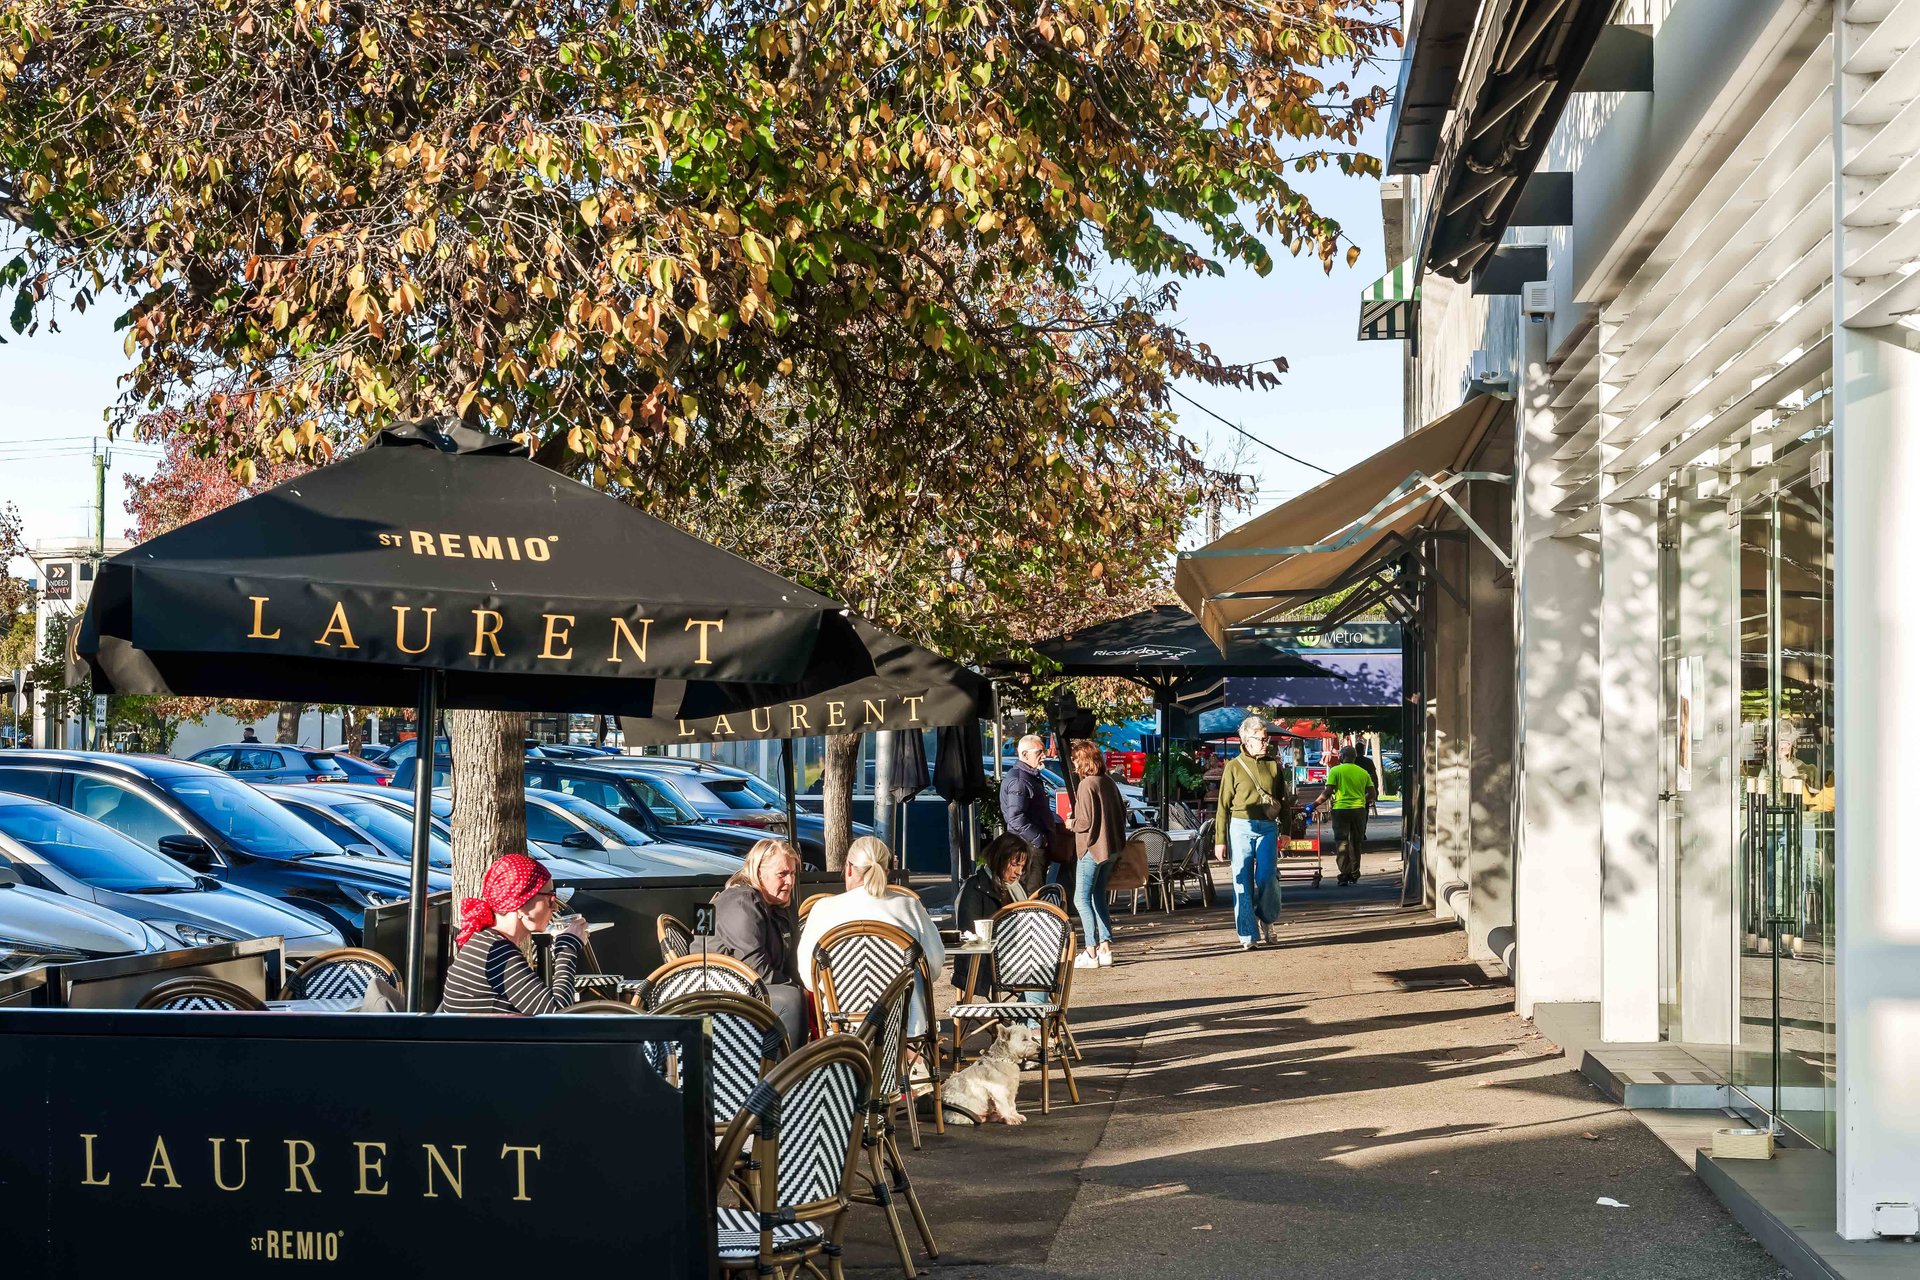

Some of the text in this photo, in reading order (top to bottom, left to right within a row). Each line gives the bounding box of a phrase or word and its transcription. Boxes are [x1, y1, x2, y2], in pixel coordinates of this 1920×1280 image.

[378, 533, 402, 547] ST
[247, 596, 724, 665] LAURENT
[1324, 630, 1363, 644] Metro
[678, 695, 923, 736] LAURENT
[697, 908, 712, 931] 21
[80, 1133, 541, 1201] LAURENT
[251, 1237, 263, 1251] ST
